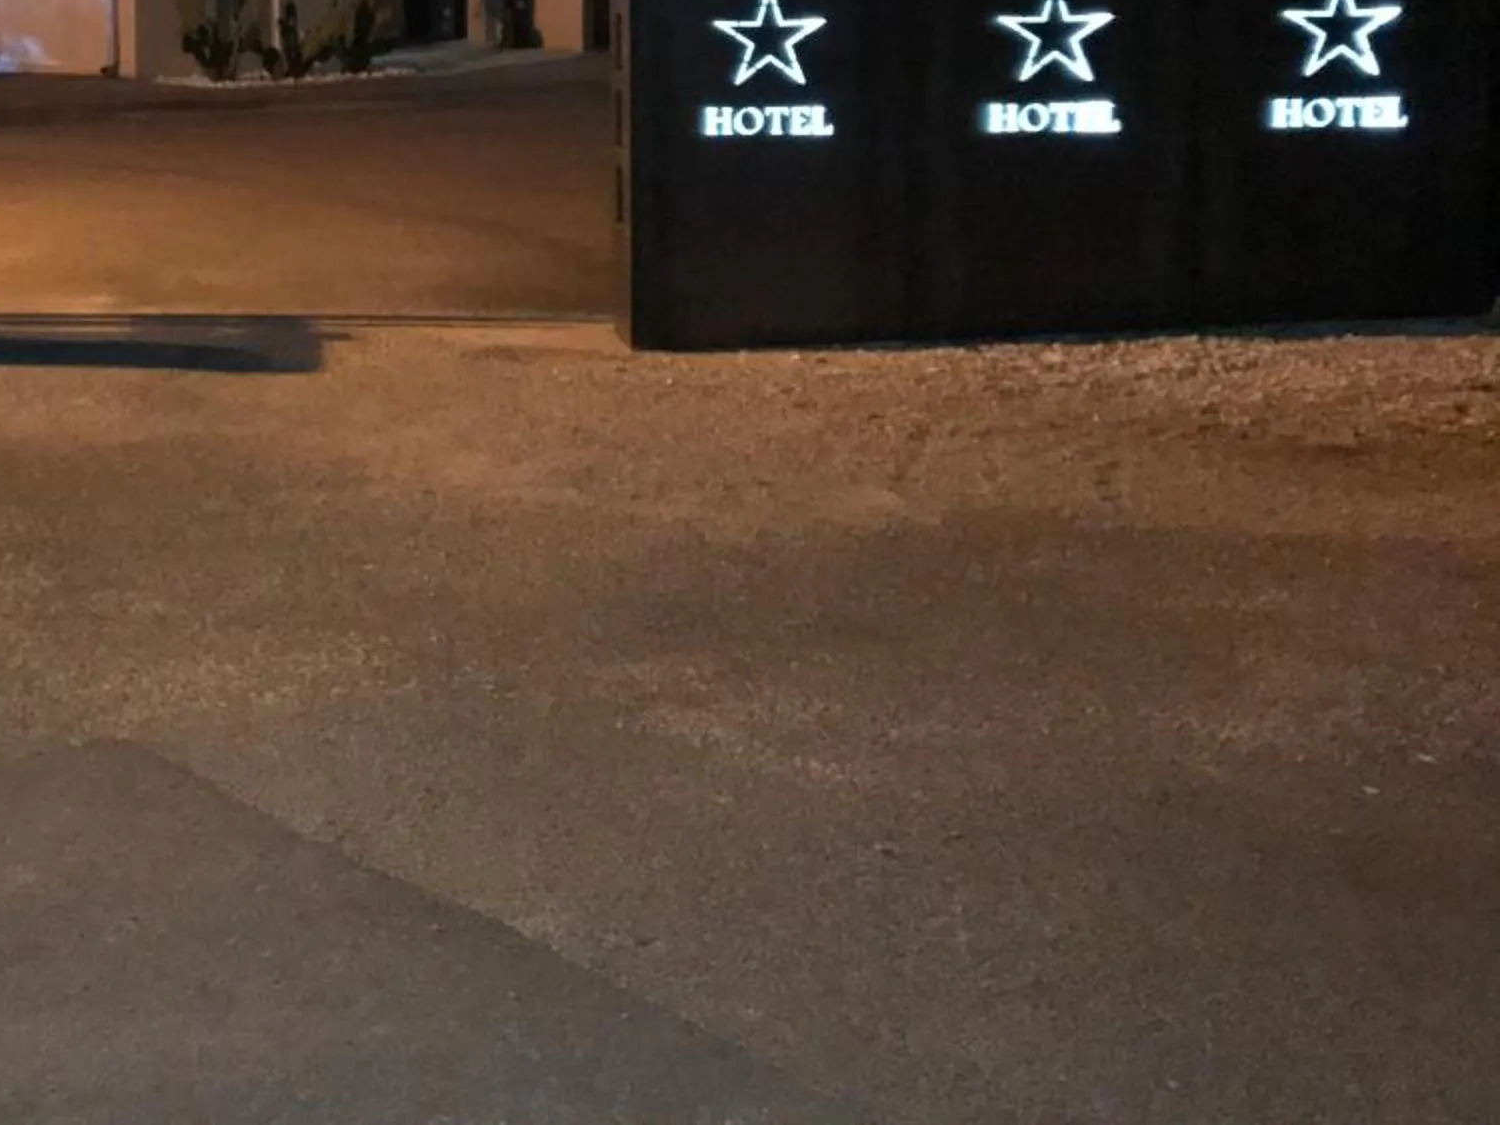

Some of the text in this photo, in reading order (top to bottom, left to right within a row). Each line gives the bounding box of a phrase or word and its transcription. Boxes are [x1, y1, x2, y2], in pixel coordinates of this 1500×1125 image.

[703, 104, 835, 137] HOTEL
[986, 98, 1123, 135] HOTEL
[1269, 94, 1409, 130] HOTEL
